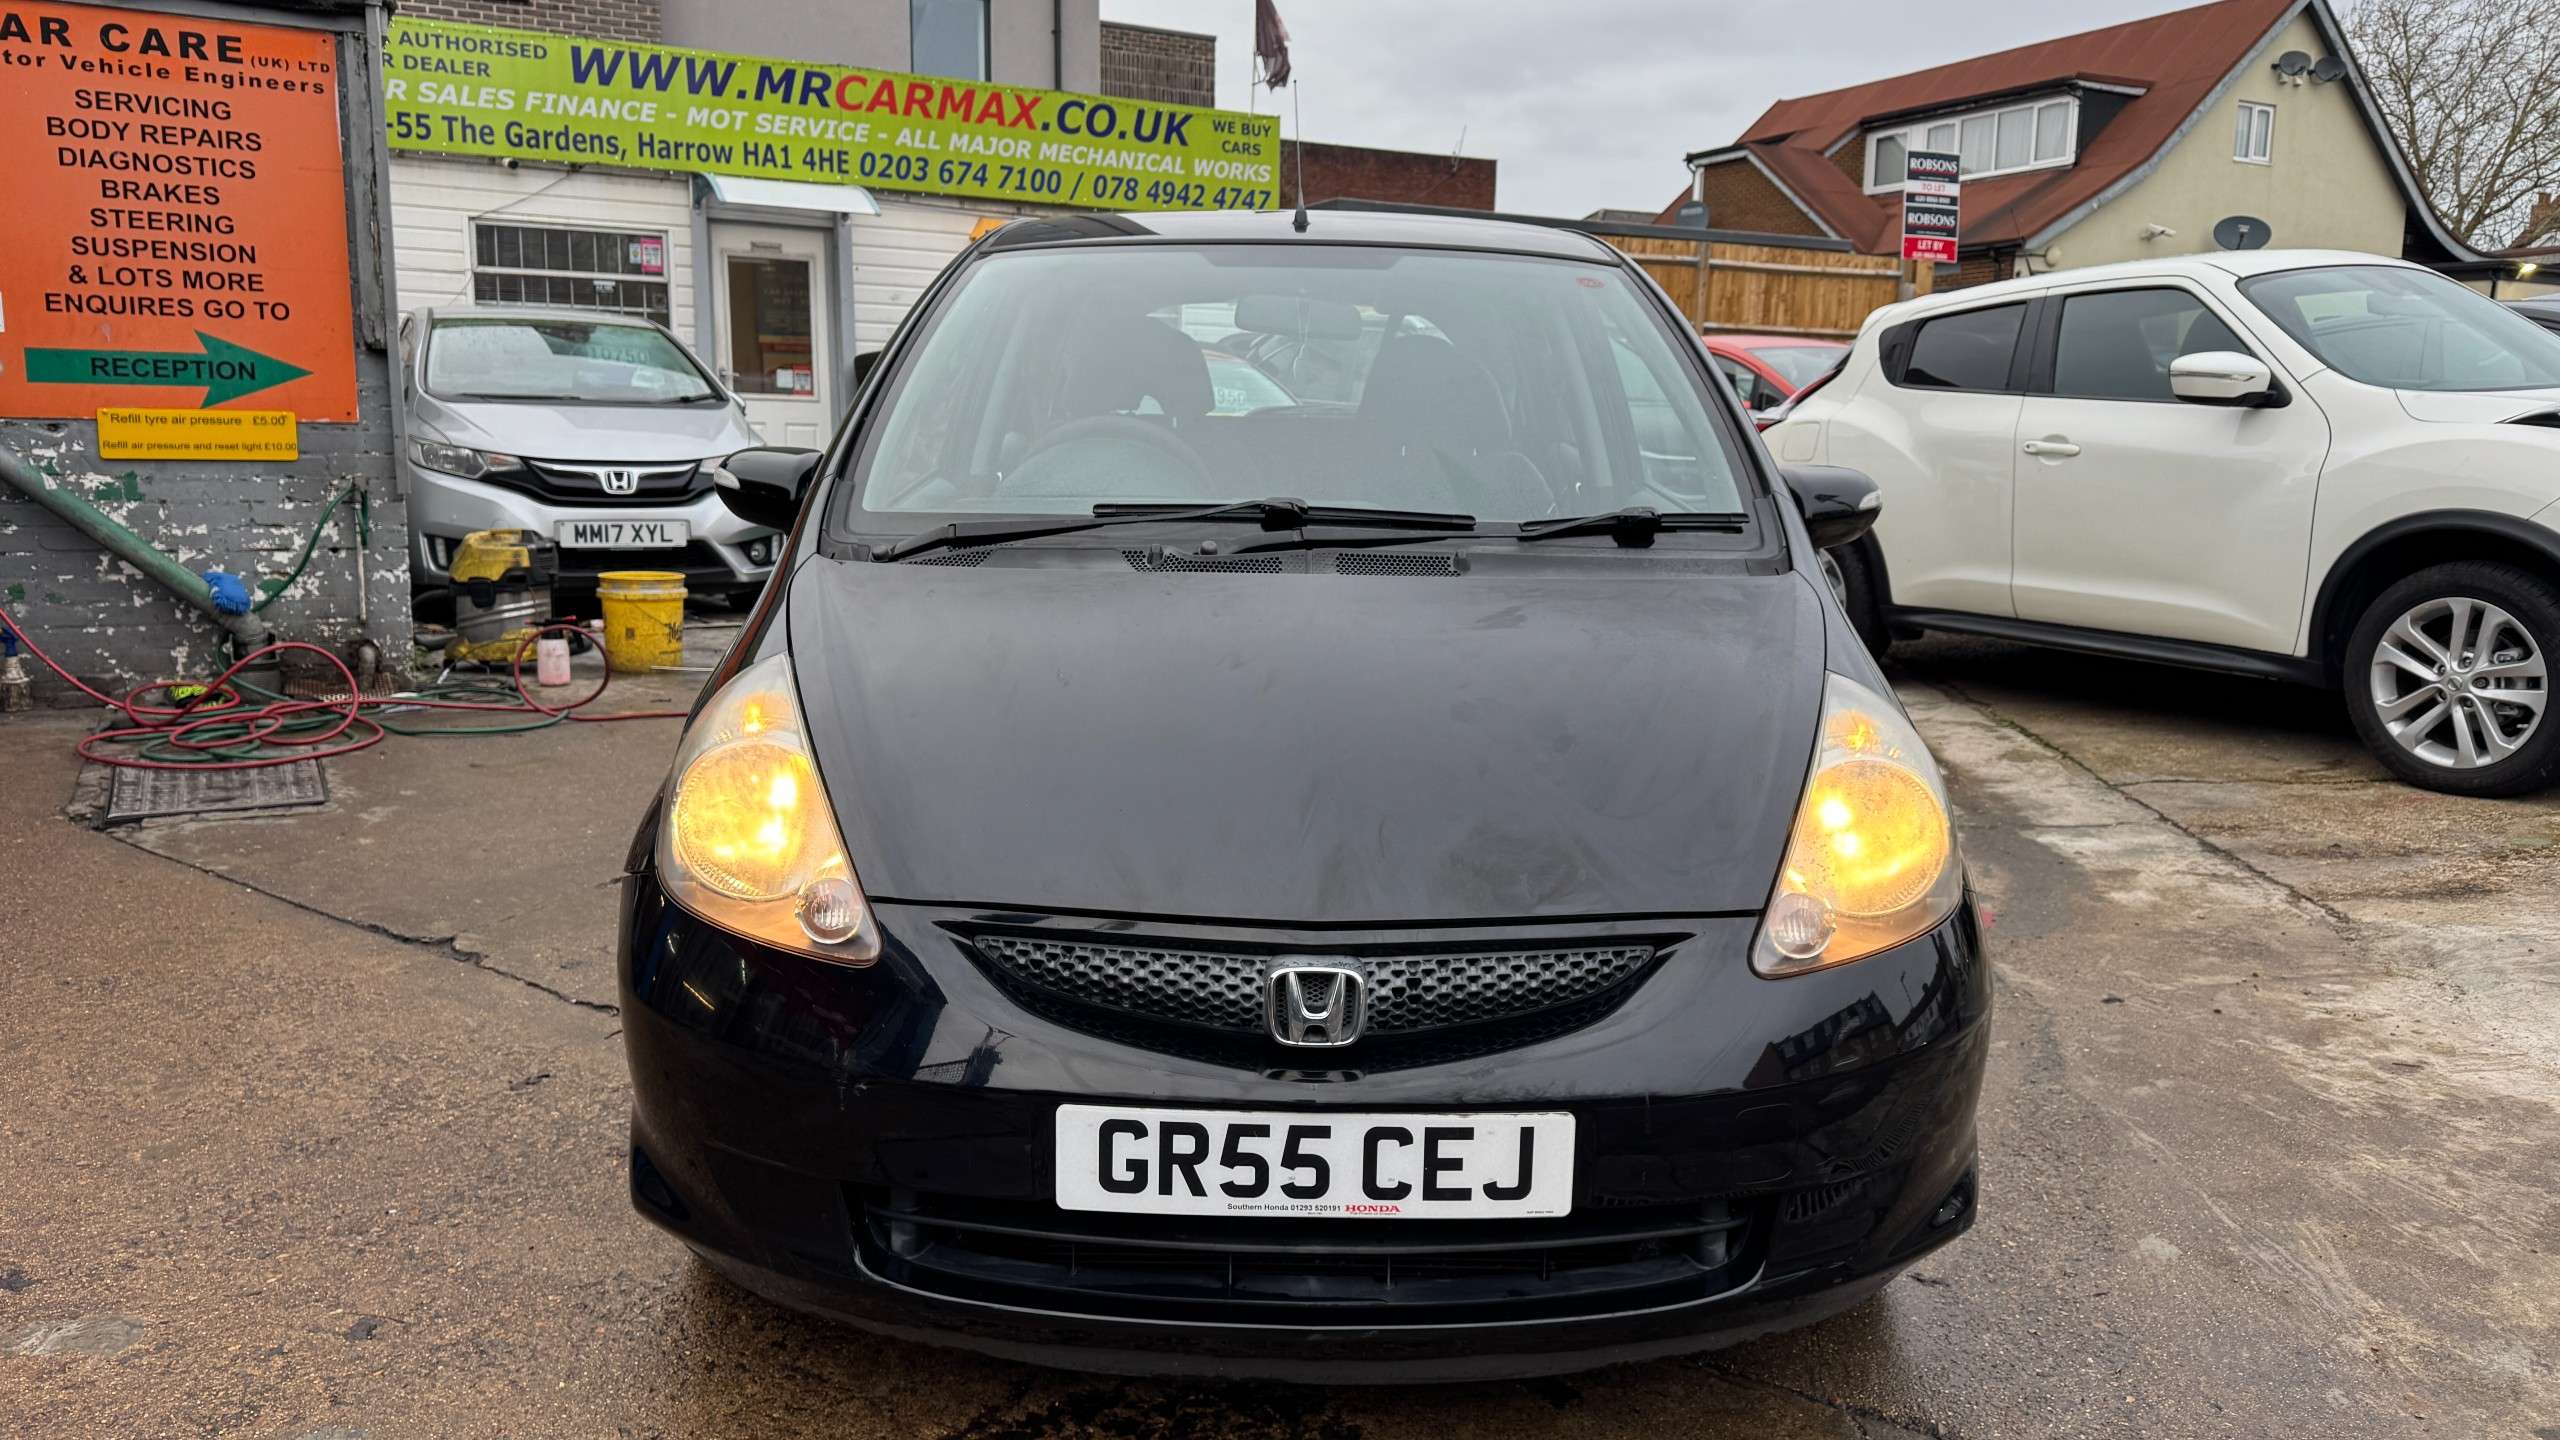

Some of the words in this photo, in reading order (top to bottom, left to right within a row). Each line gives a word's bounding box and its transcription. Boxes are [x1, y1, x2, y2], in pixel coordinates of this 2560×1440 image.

[0, 13, 72, 48] AR
[100, 23, 244, 65] CARE
[251, 55, 290, 73] (UK)
[298, 61, 331, 74] LTD
[399, 31, 548, 61] AUTHORISED
[59, 53, 171, 80] Vehicle
[185, 66, 326, 95] Engineers
[403, 54, 491, 79] DEALER
[74, 88, 232, 121] SERVICING
[570, 45, 1195, 147] WWW.MRCARMAX.CO.UK
[46, 116, 130, 143] BODY
[140, 124, 262, 152] REPAIRS
[385, 78, 407, 101] R
[417, 81, 515, 112] SALES
[525, 91, 658, 124] FINANCE
[687, 107, 749, 132] MOT
[755, 114, 870, 145] SERVICE
[896, 127, 942, 151] ALL
[949, 133, 1032, 160] MAJOR
[1037, 142, 1185, 176] MECHANICAL
[1194, 158, 1272, 184] WORKS
[1211, 119, 1236, 135] WE
[1241, 121, 1272, 138] BUY
[1221, 139, 1262, 157] CARS
[58, 146, 257, 180] DIAGNOSTICS
[441, 115, 496, 146] The
[504, 120, 628, 162] Gardens,
[638, 132, 734, 165] Harrow
[743, 142, 793, 170] HA1
[801, 144, 850, 175] 4HE
[859, 151, 929, 183] 0203
[938, 163, 988, 188] 674
[997, 167, 1062, 195] 7100
[1093, 175, 1138, 202] 078
[1145, 179, 1206, 208] 4942
[1212, 186, 1272, 211] 4747
[1910, 157, 1958, 172] ROBSONS
[100, 179, 221, 206] BRAKES
[89, 207, 235, 235] STEERING
[1907, 212, 1955, 227] ROBSONS
[71, 236, 257, 264] SUSPENSION
[68, 264, 88, 285] &
[97, 266, 174, 289] LOTS
[183, 270, 265, 293] MORE
[44, 292, 195, 318] ENQUIRES
[204, 299, 246, 320] GO
[253, 301, 291, 322] TO
[90, 357, 257, 381] RECEPTION
[110, 412, 141, 425] Refill
[145, 414, 168, 427] tyre
[171, 413, 186, 426] air
[190, 415, 242, 427] pressure
[252, 414, 287, 426] £5.00
[102, 440, 129, 450] Refill
[131, 441, 144, 450] air
[146, 442, 191, 452] pressure
[193, 441, 213, 451] and
[214, 442, 239, 451] reset
[242, 441, 264, 453] light
[574, 523, 623, 544] MM17
[631, 523, 673, 543] XYL
[1098, 1118, 1332, 1200] GR55
[1362, 1125, 1535, 1202] CEJ
[1227, 1202, 1263, 1211] Southern
[1264, 1203, 1289, 1212] Honda
[1290, 1203, 1313, 1212] 01293
[1314, 1204, 1341, 1212] 520191
[1344, 1204, 1401, 1213] HONDA
